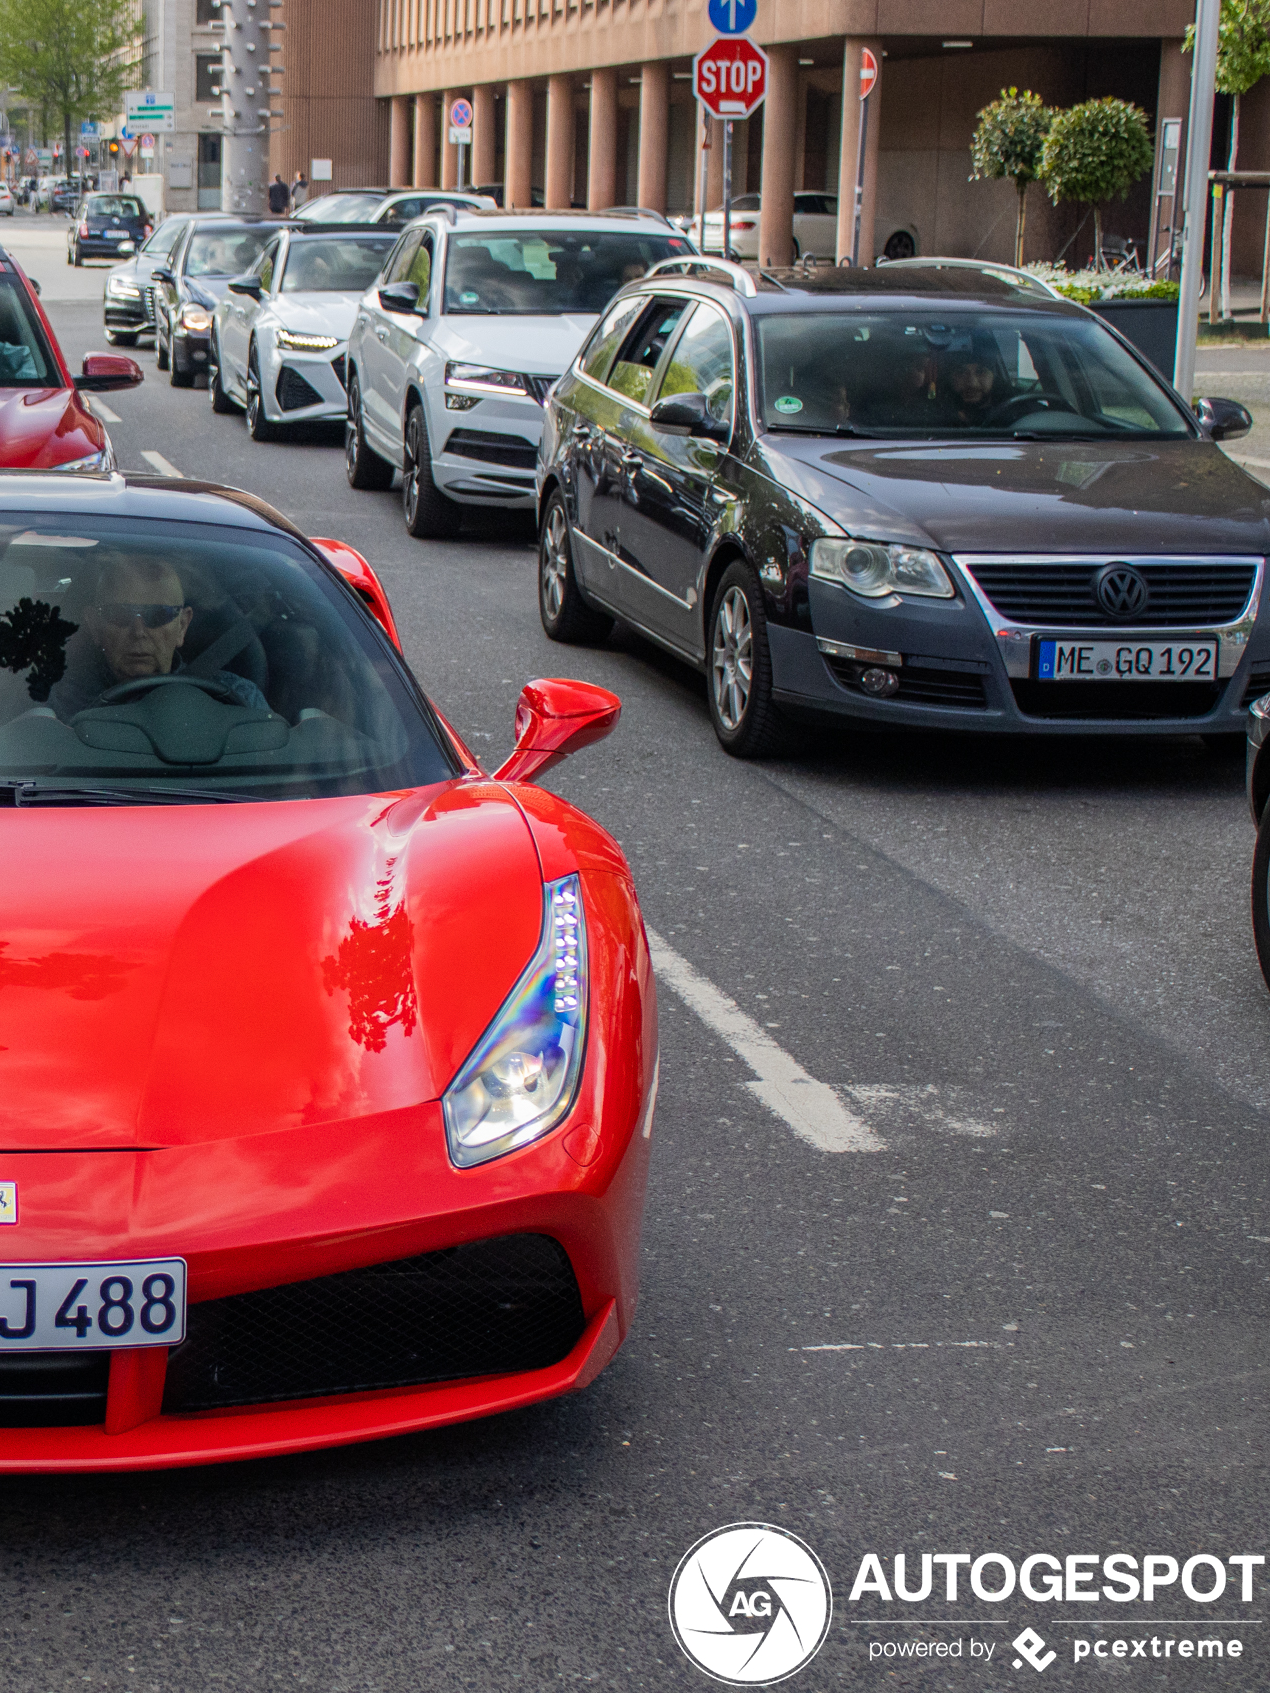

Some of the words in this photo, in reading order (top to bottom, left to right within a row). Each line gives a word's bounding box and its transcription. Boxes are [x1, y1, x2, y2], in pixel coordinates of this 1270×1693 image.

[700, 60, 762, 94] STOP
[1042, 663, 1050, 672] D
[1056, 646, 1094, 675] ME
[1115, 647, 1153, 677] GQ
[1159, 647, 1212, 676] 192
[54, 1273, 177, 1339] 488
